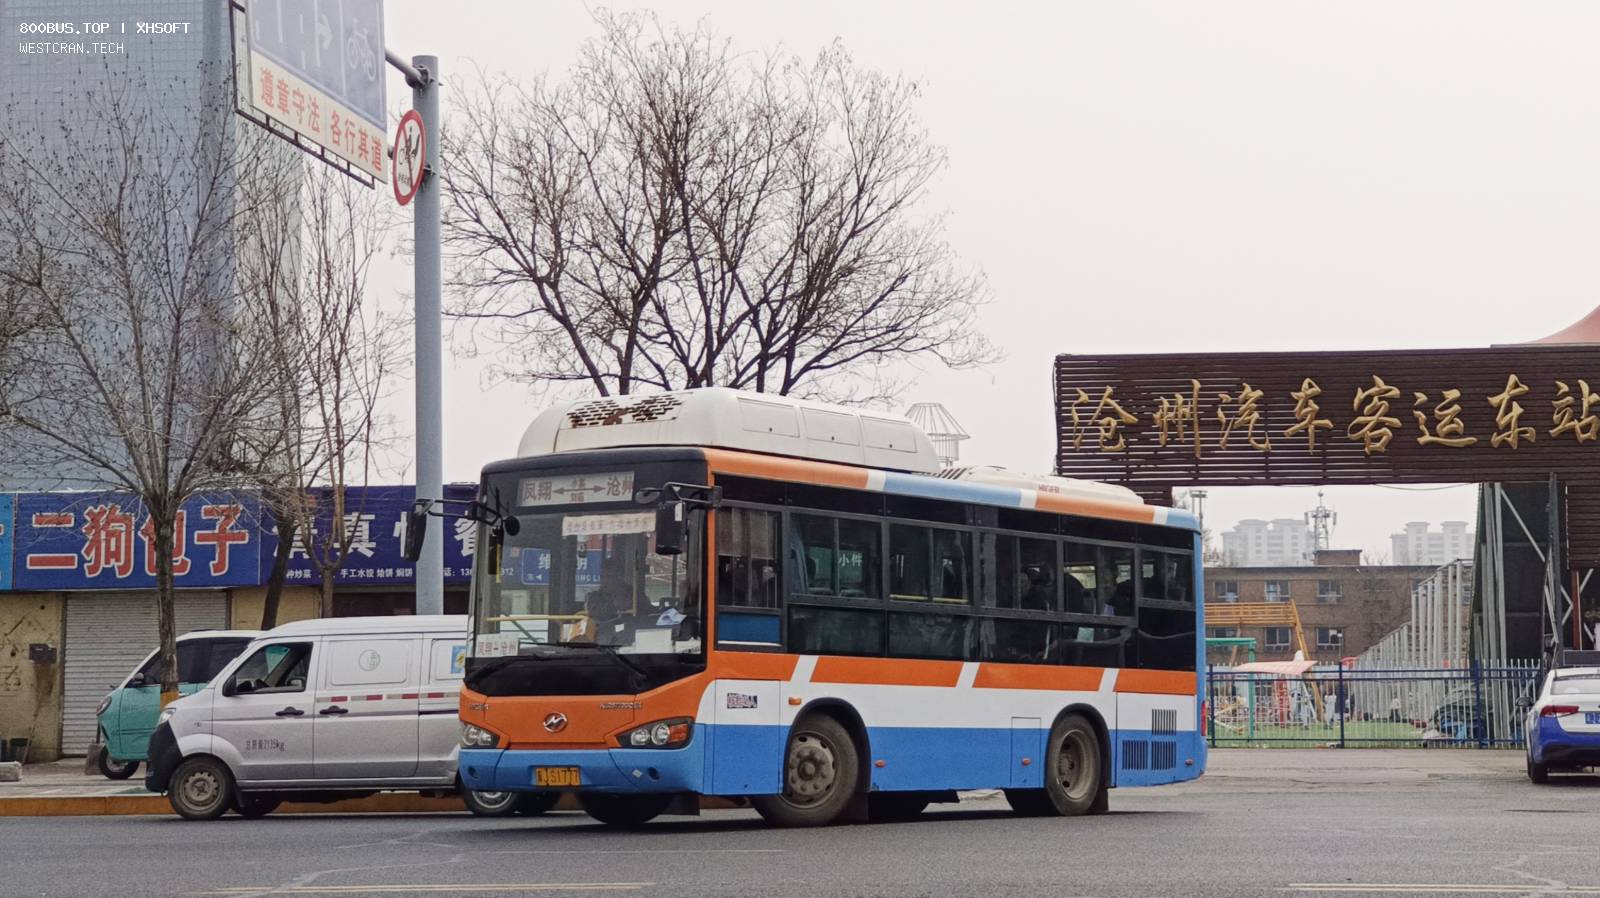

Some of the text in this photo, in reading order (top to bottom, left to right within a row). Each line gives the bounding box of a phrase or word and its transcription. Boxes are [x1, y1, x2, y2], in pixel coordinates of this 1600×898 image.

[260, 66, 383, 172] 遵章守法 各行其道
[1070, 374, 1600, 460] 沧州汽车客运东站
[26, 503, 250, 578] 二狗包子
